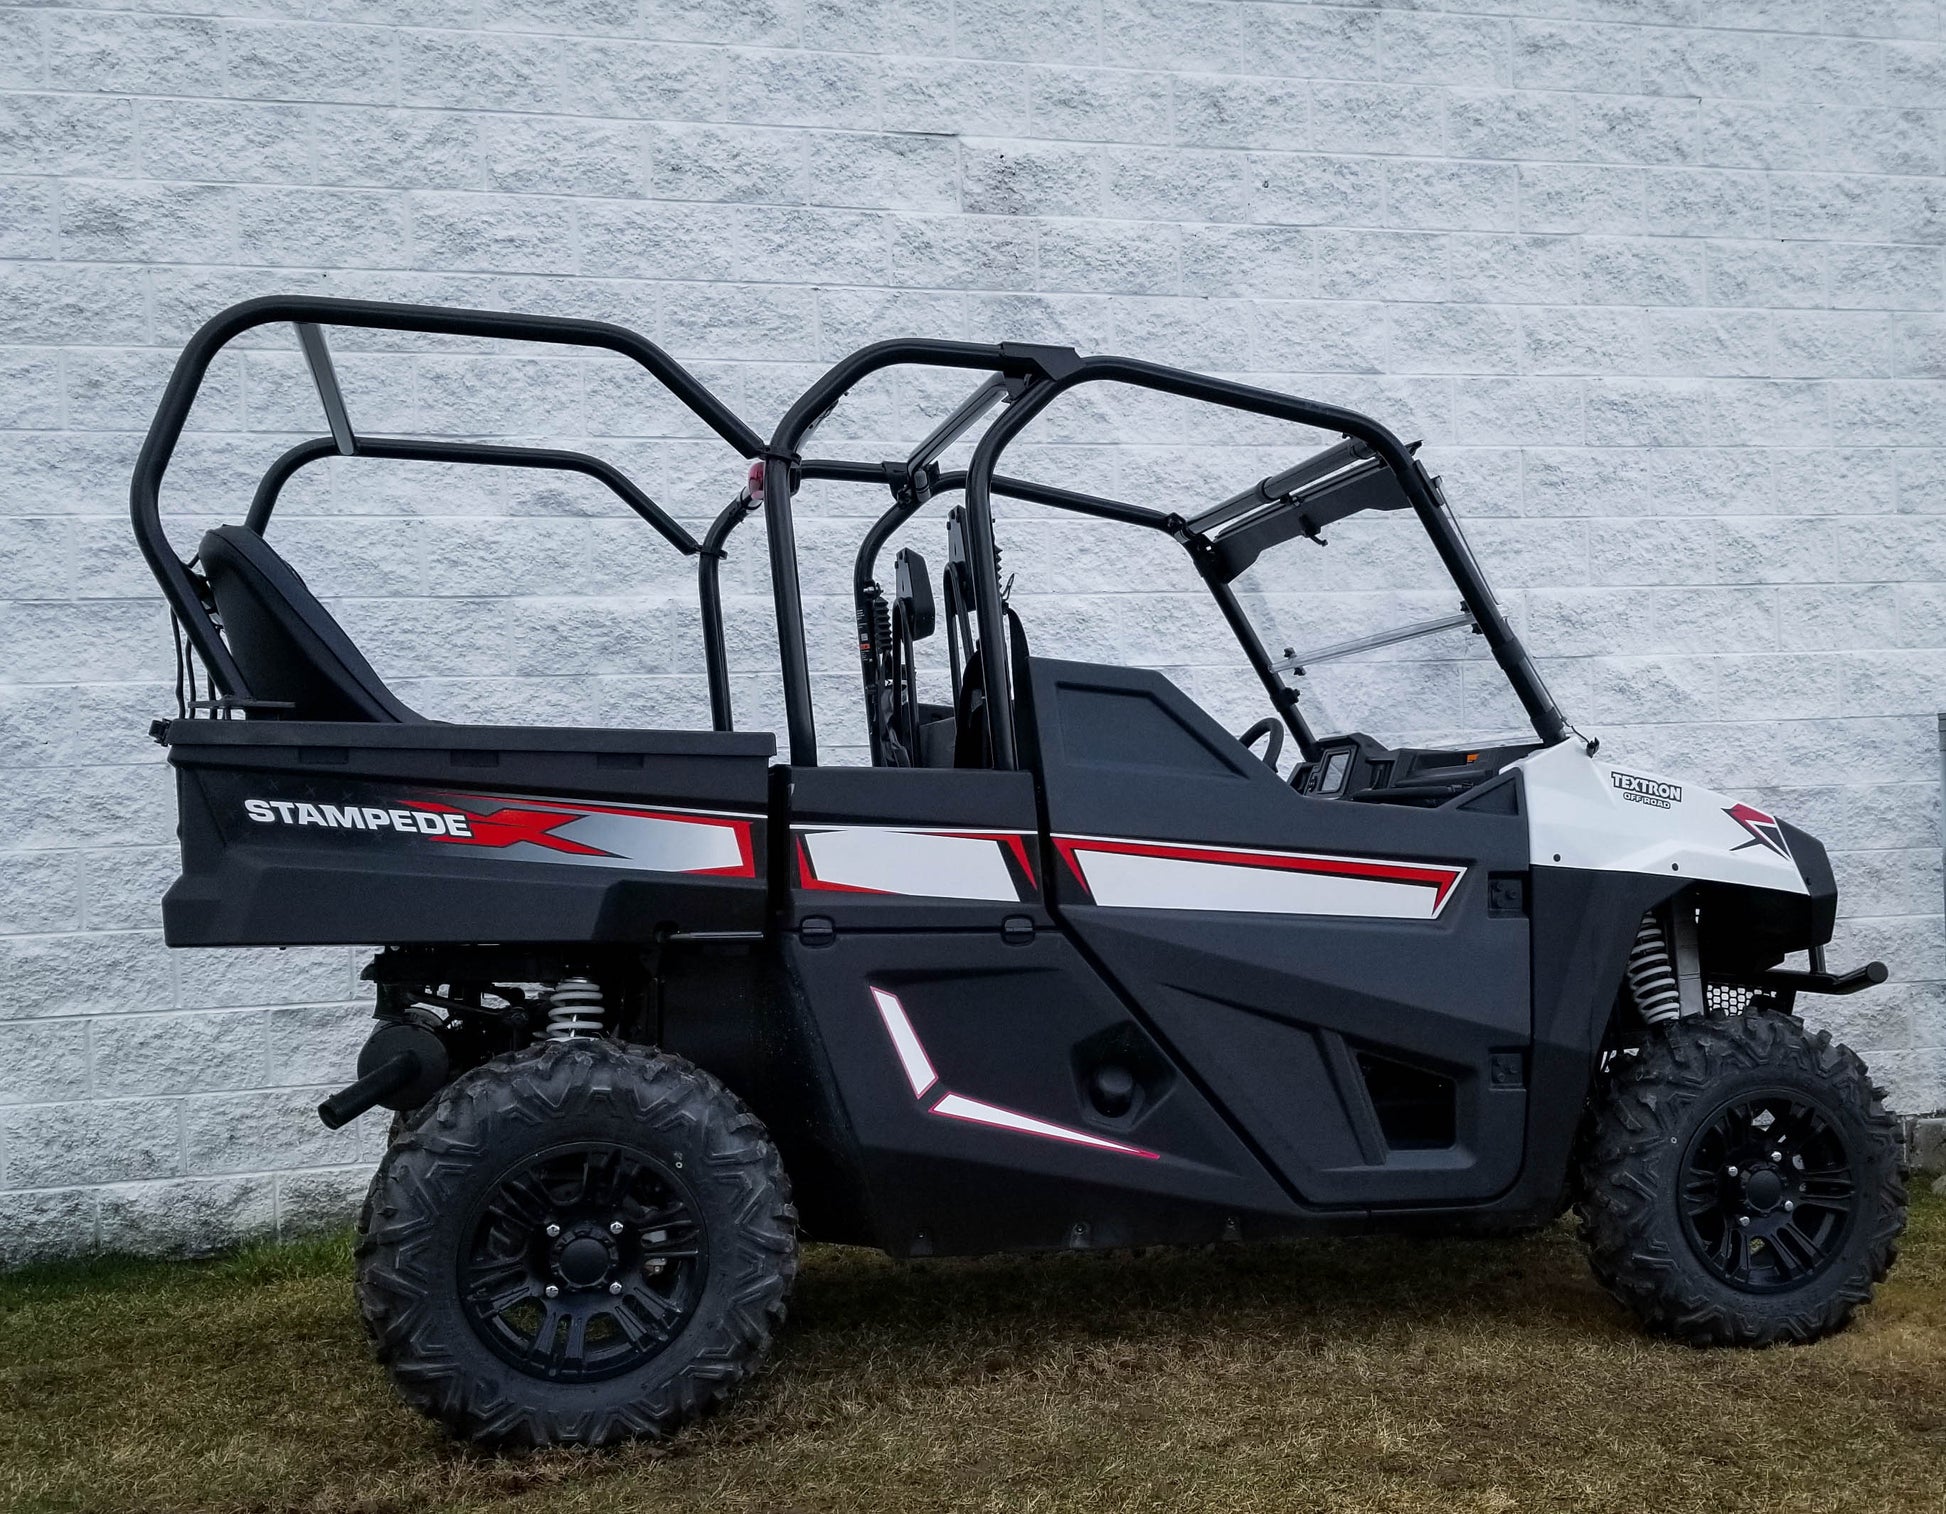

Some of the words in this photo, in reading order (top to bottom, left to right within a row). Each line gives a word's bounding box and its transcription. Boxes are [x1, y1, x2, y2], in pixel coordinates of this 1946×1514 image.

[1612, 772, 1682, 802] TEXTRON
[1623, 792, 1643, 803] OFF
[1644, 797, 1671, 809] ROAD
[245, 799, 473, 837] STAMPEDE
